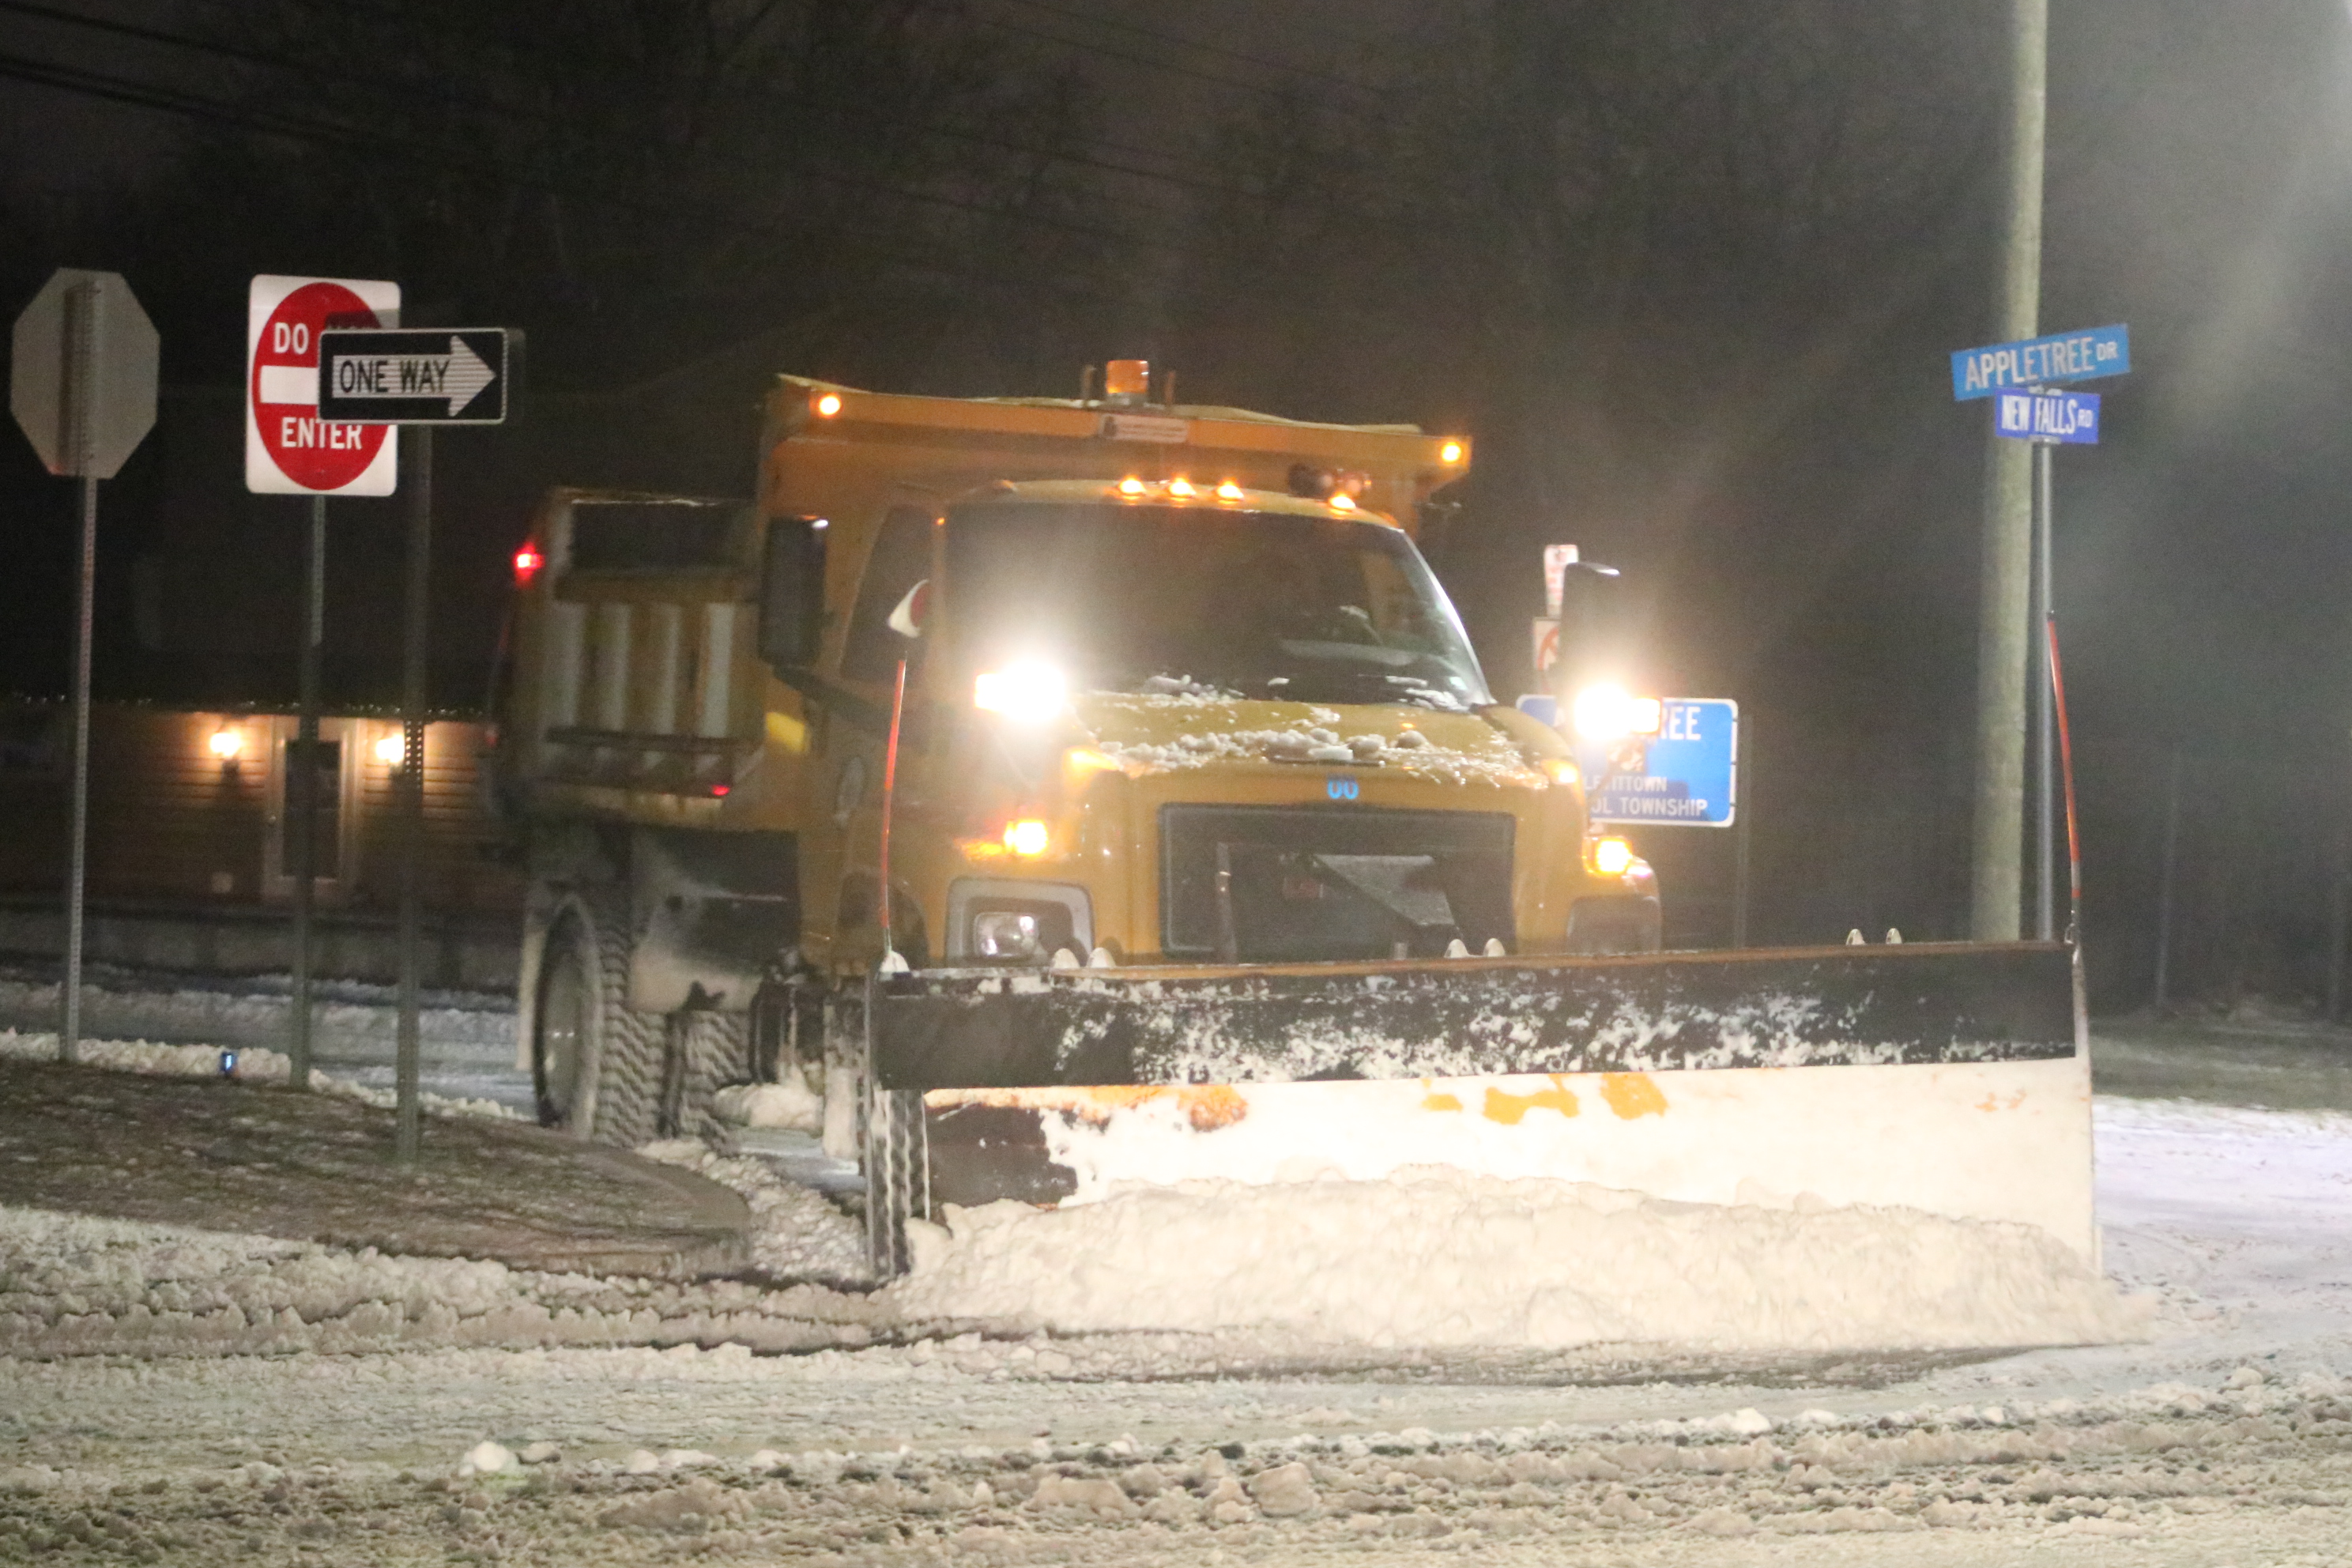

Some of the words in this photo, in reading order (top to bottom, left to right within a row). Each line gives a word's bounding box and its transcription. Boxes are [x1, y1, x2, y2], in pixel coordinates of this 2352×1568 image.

[274, 322, 309, 355] DO
[340, 360, 388, 393] ONE
[399, 360, 450, 393] WAY
[1966, 337, 2095, 391] APPLETREE
[2097, 341, 2118, 361] DR
[2034, 397, 2078, 435] FALLS
[281, 416, 362, 450] ENTER
[1584, 775, 1668, 793] LEITTOWN
[1619, 797, 1708, 816] TOWNSHIP
